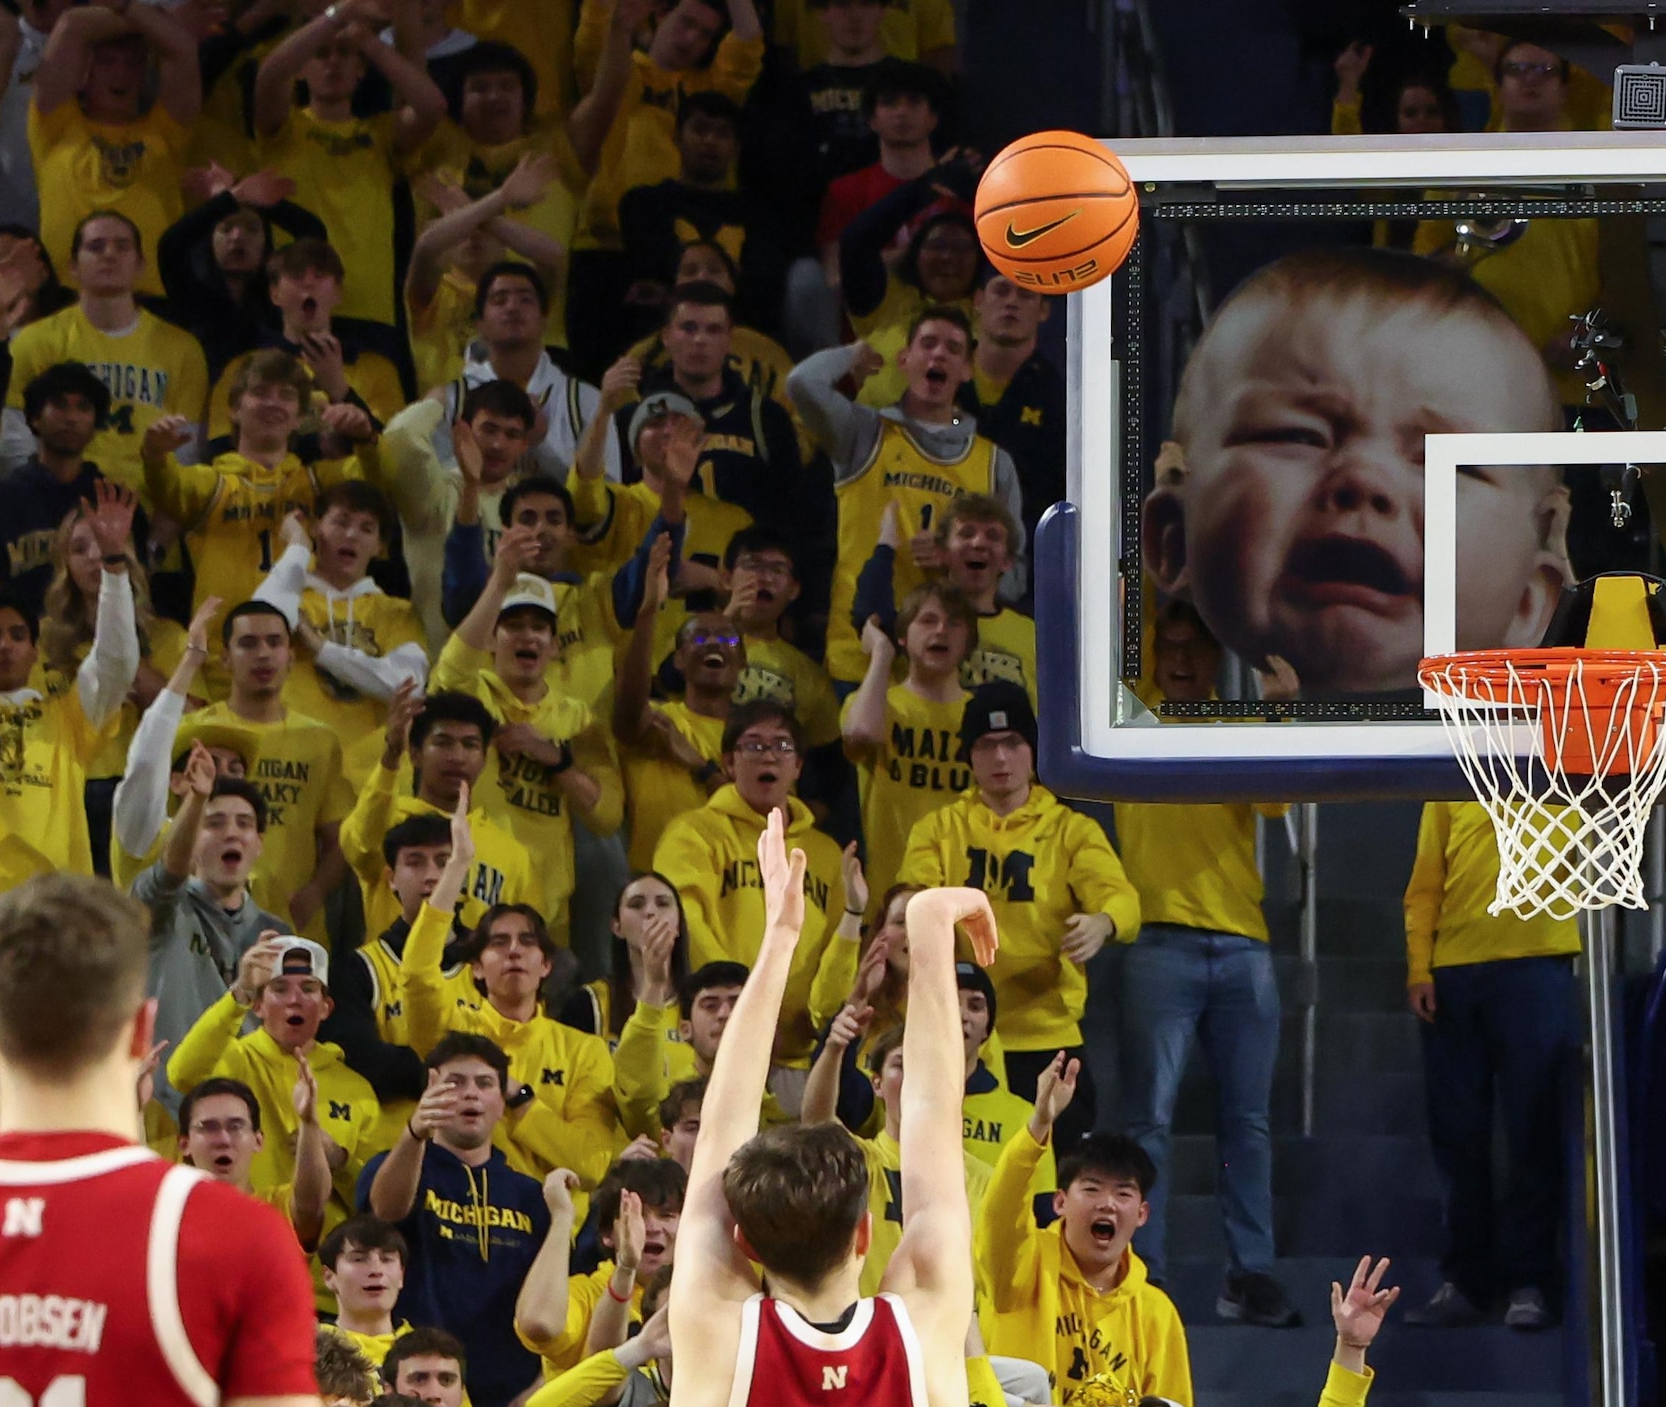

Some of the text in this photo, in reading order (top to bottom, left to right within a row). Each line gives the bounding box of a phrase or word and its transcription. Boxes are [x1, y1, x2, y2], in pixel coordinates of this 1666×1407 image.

[90, 362, 169, 409] HIGAN
[883, 471, 967, 498] MICHIGA
[257, 528, 271, 572] 1
[892, 720, 971, 763] MAIZ
[909, 763, 971, 792] BLU
[721, 859, 829, 910] MICAN
[541, 1066, 566, 1087] M
[328, 1099, 351, 1122] M
[961, 1117, 1002, 1145] GAN
[1, 1197, 45, 1237] N
[426, 1190, 533, 1235] MICHIGAN
[821, 1365, 849, 1391] N
